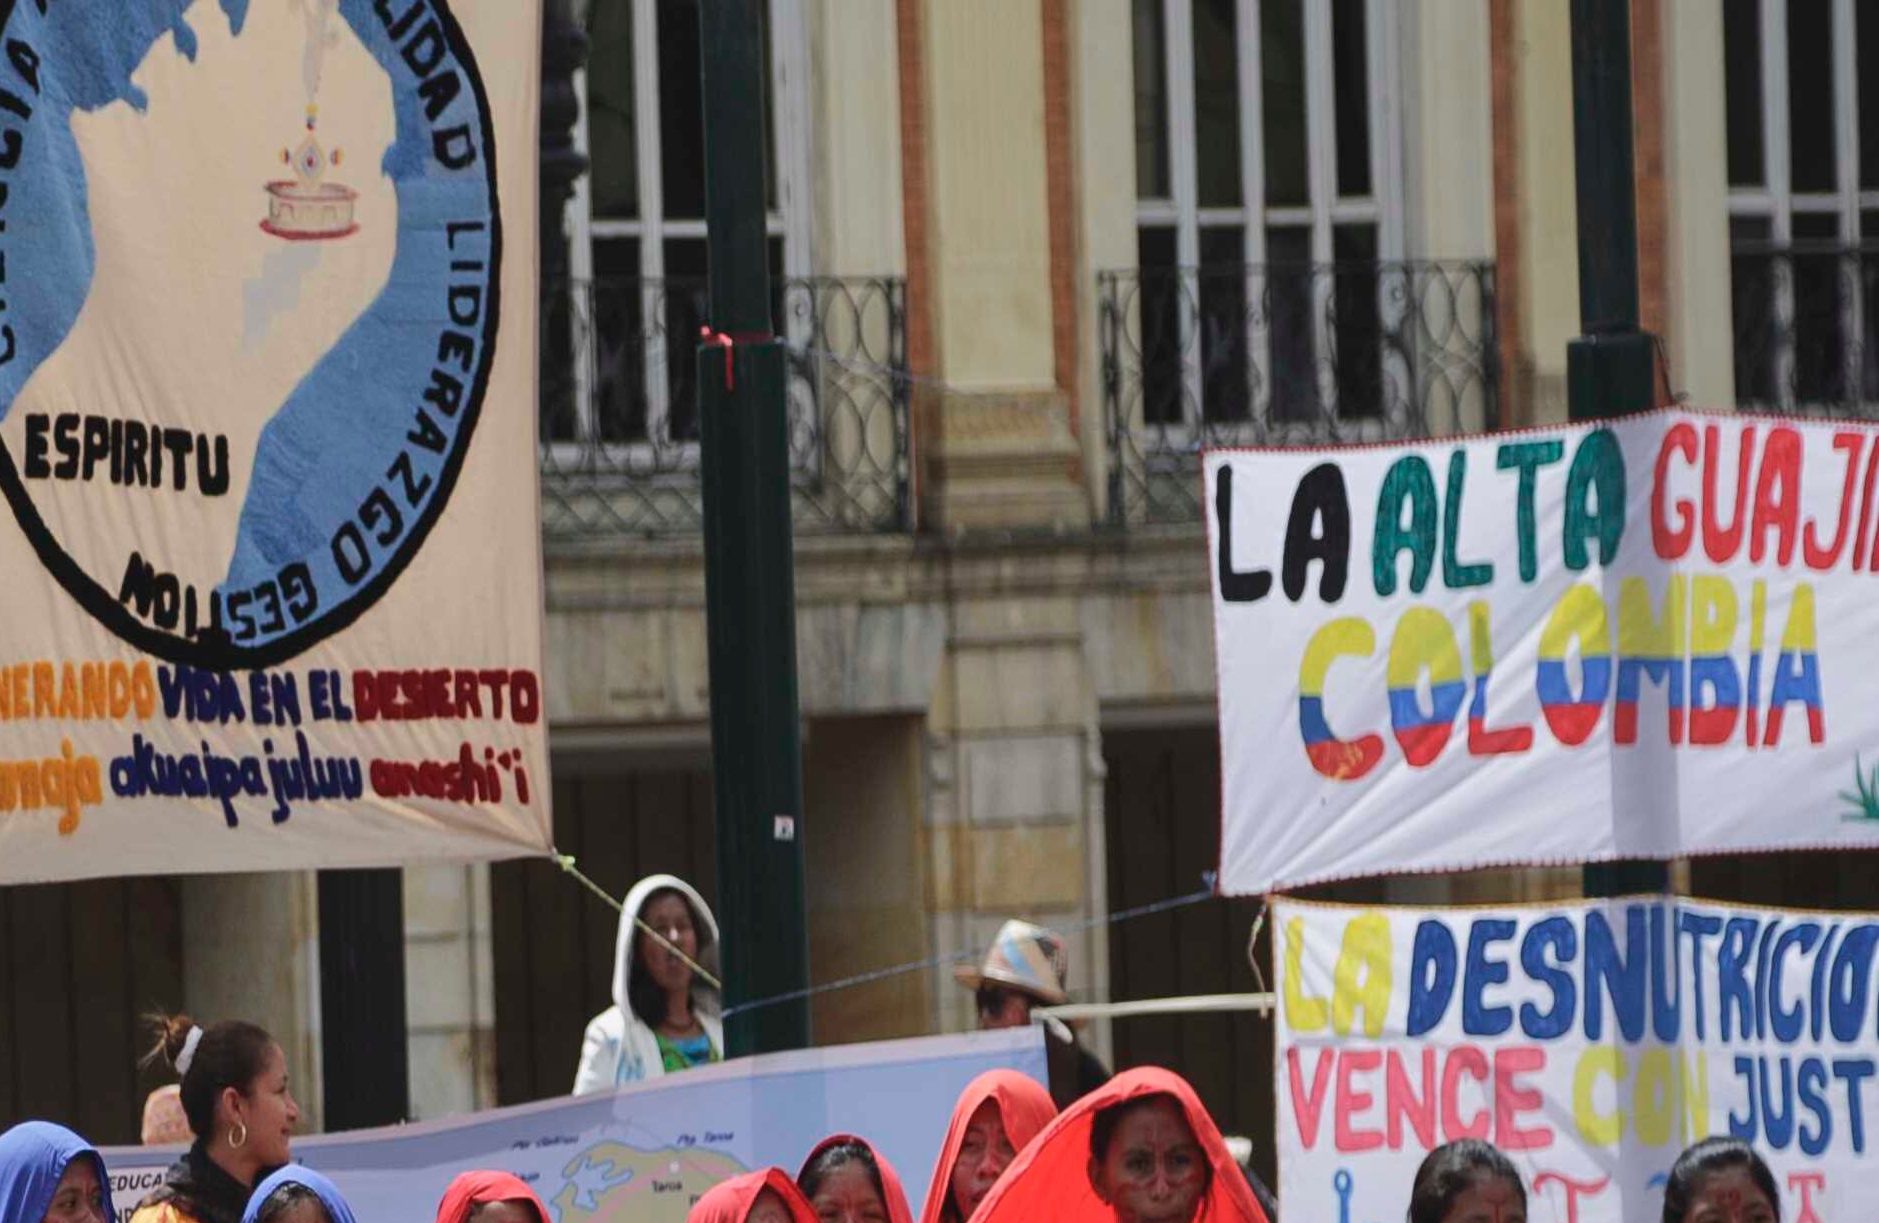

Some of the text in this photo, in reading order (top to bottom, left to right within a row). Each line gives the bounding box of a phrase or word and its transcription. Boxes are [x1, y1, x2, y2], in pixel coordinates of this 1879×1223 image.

[24, 413, 229, 496] ESPIRITU
[331, 221, 485, 585] LIDERAZGO
[1215, 422, 1879, 602] LA ALTA GUAJI
[158, 664, 246, 725] VIDA
[249, 671, 302, 727] EN
[308, 669, 353, 721] EL
[1298, 574, 1825, 781] COLOMBIA
[1284, 904, 1879, 1044] LA DESNUTRICIO
[1287, 1045, 1875, 1156] VENCE CON JUST
[110, 1173, 168, 1197] EDUCA
